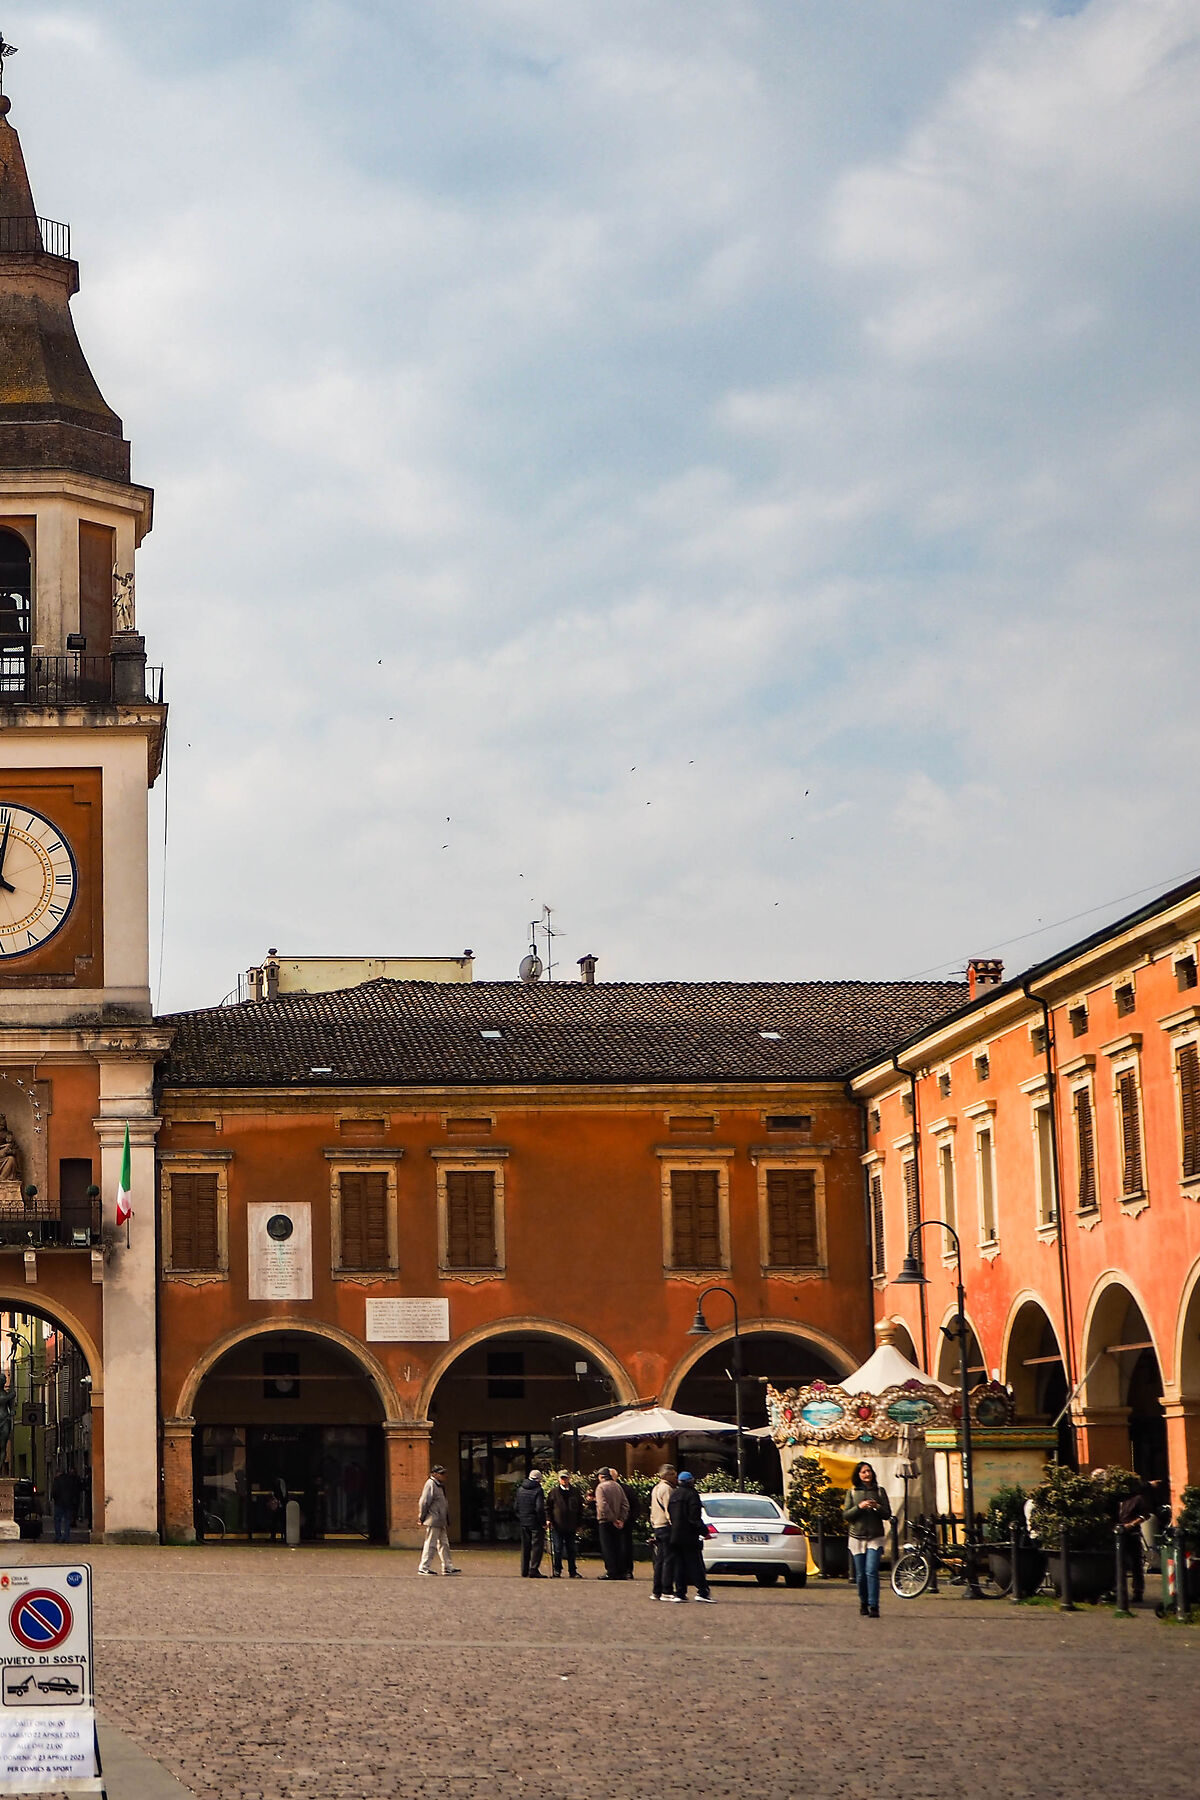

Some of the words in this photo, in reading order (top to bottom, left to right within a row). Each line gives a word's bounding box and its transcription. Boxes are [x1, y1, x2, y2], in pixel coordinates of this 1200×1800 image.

[46, 841, 63, 854] II
[55, 874, 72, 885] III
[47, 903, 64, 921] IV
[26, 930, 39, 946] V
[39, 1656, 49, 1664] DI
[53, 1655, 87, 1664] SOSTA
